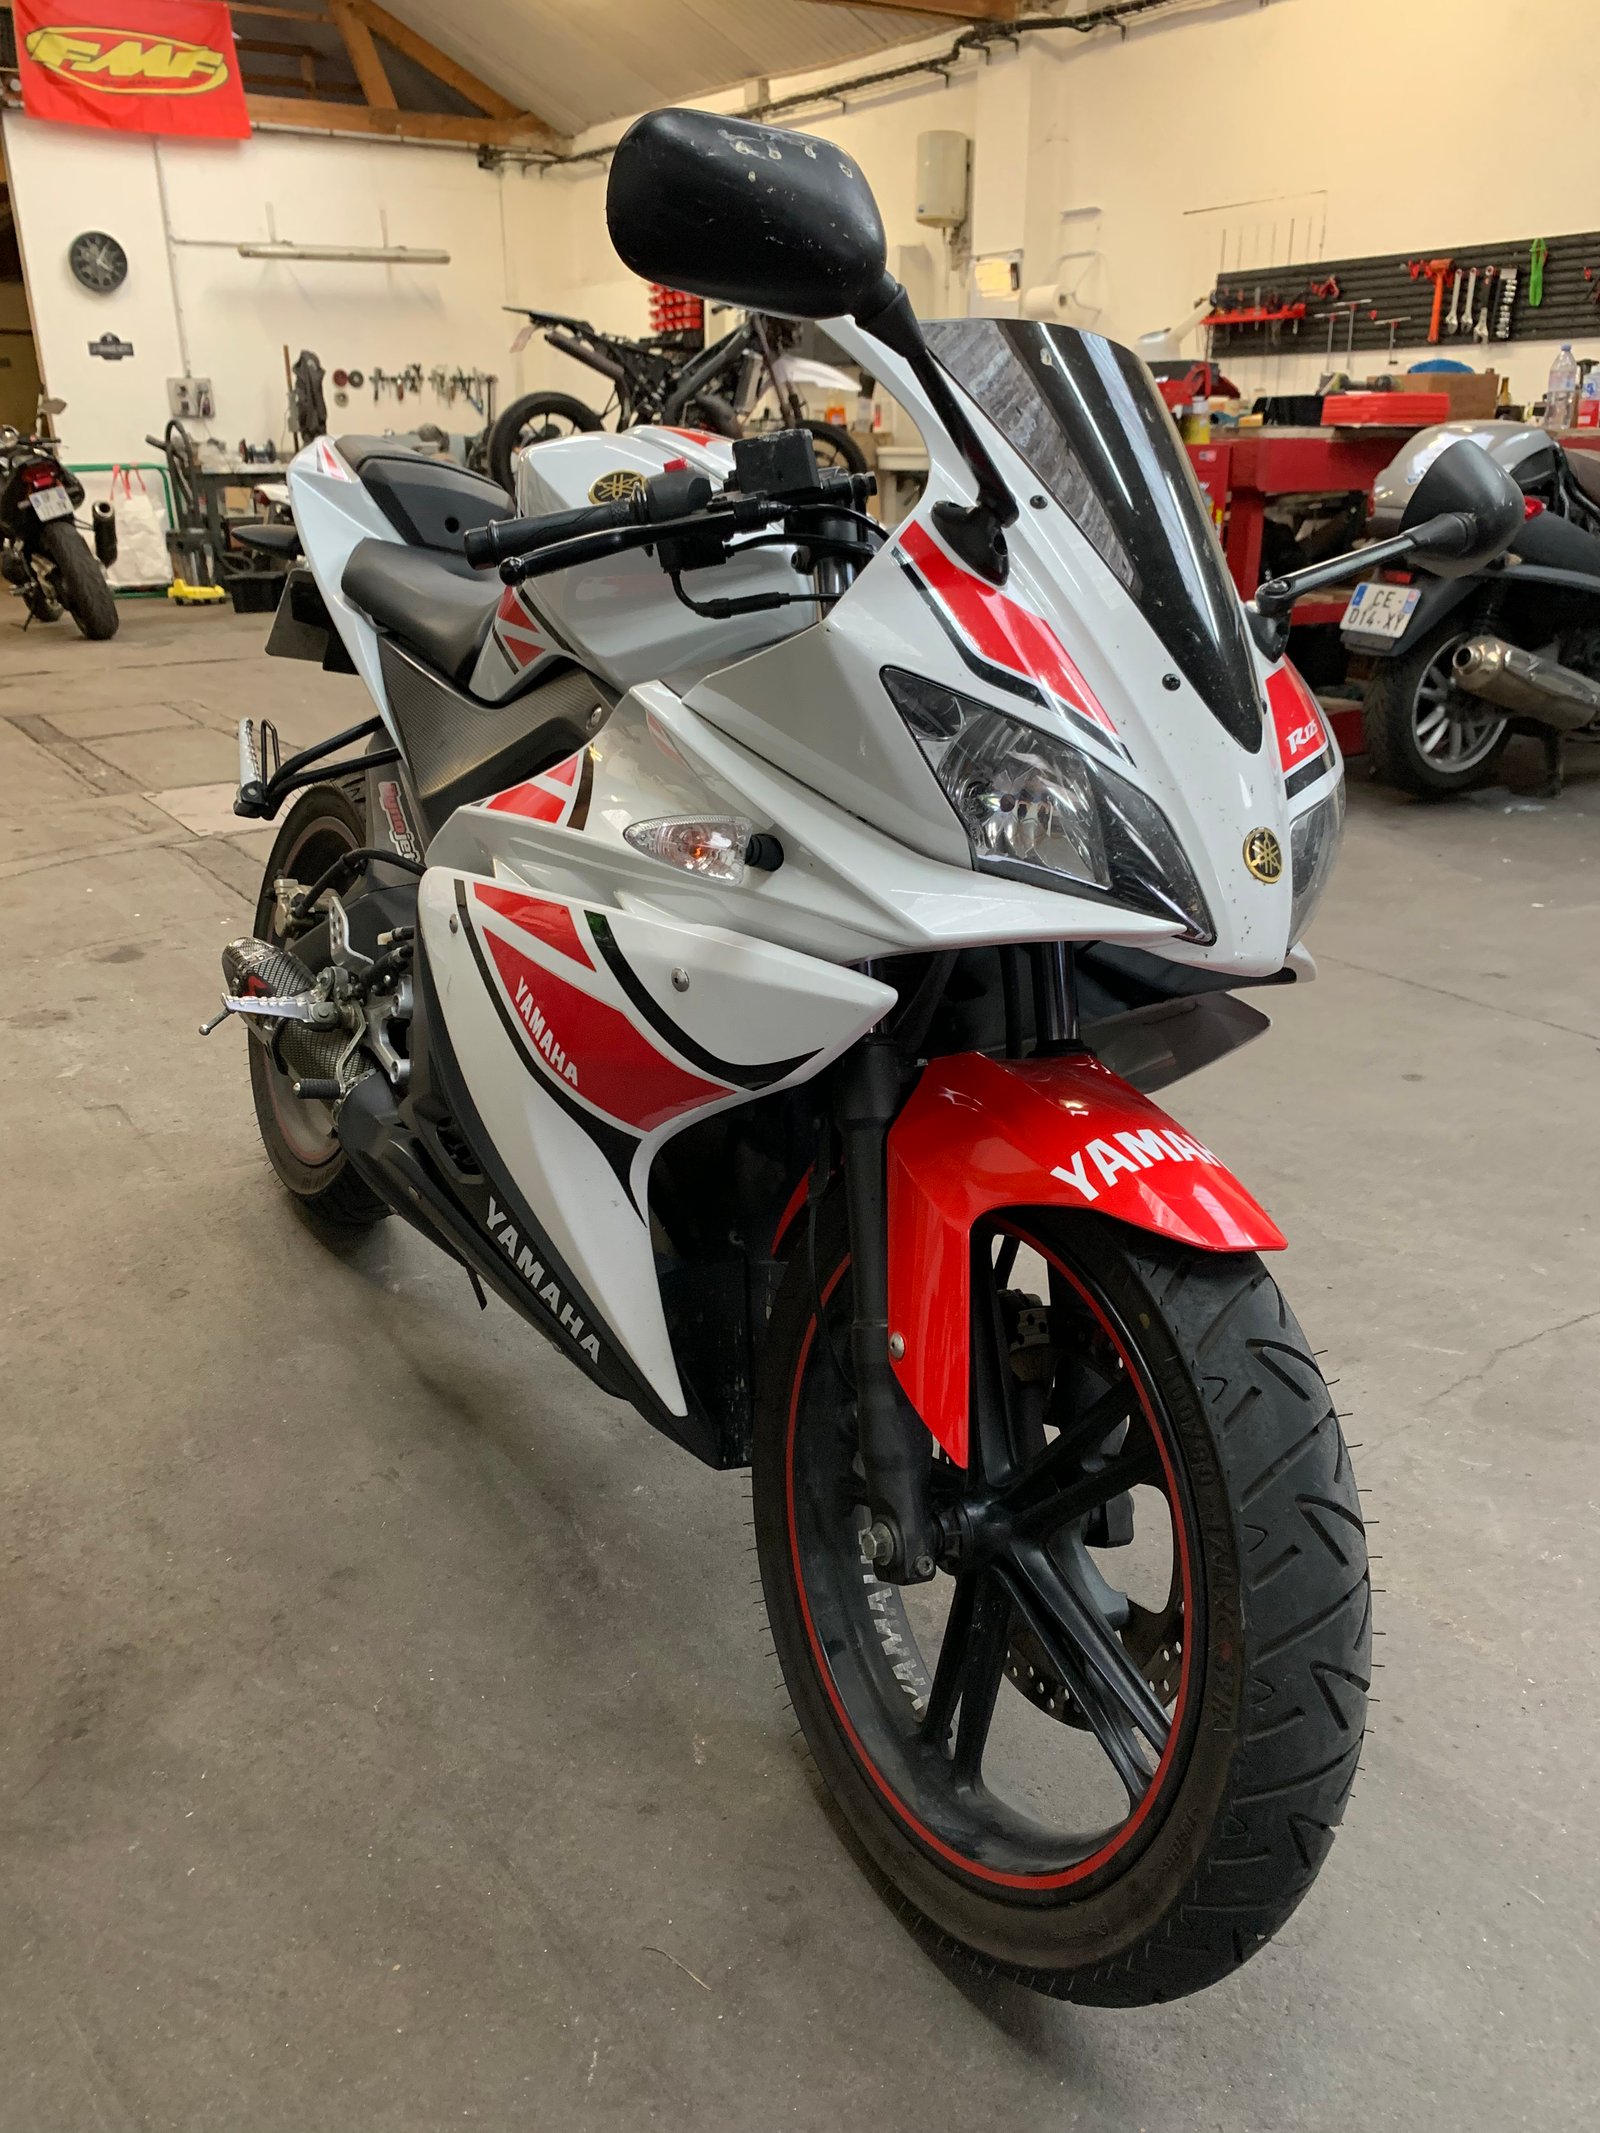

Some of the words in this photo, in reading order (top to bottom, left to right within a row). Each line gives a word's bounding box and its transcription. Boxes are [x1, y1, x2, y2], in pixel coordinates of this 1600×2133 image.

[31, 32, 224, 78] FMF
[515, 975, 578, 1087] YAMAHA
[486, 1195, 600, 1364] YAMAHA
[857, 1527, 931, 1712] YAMAH
